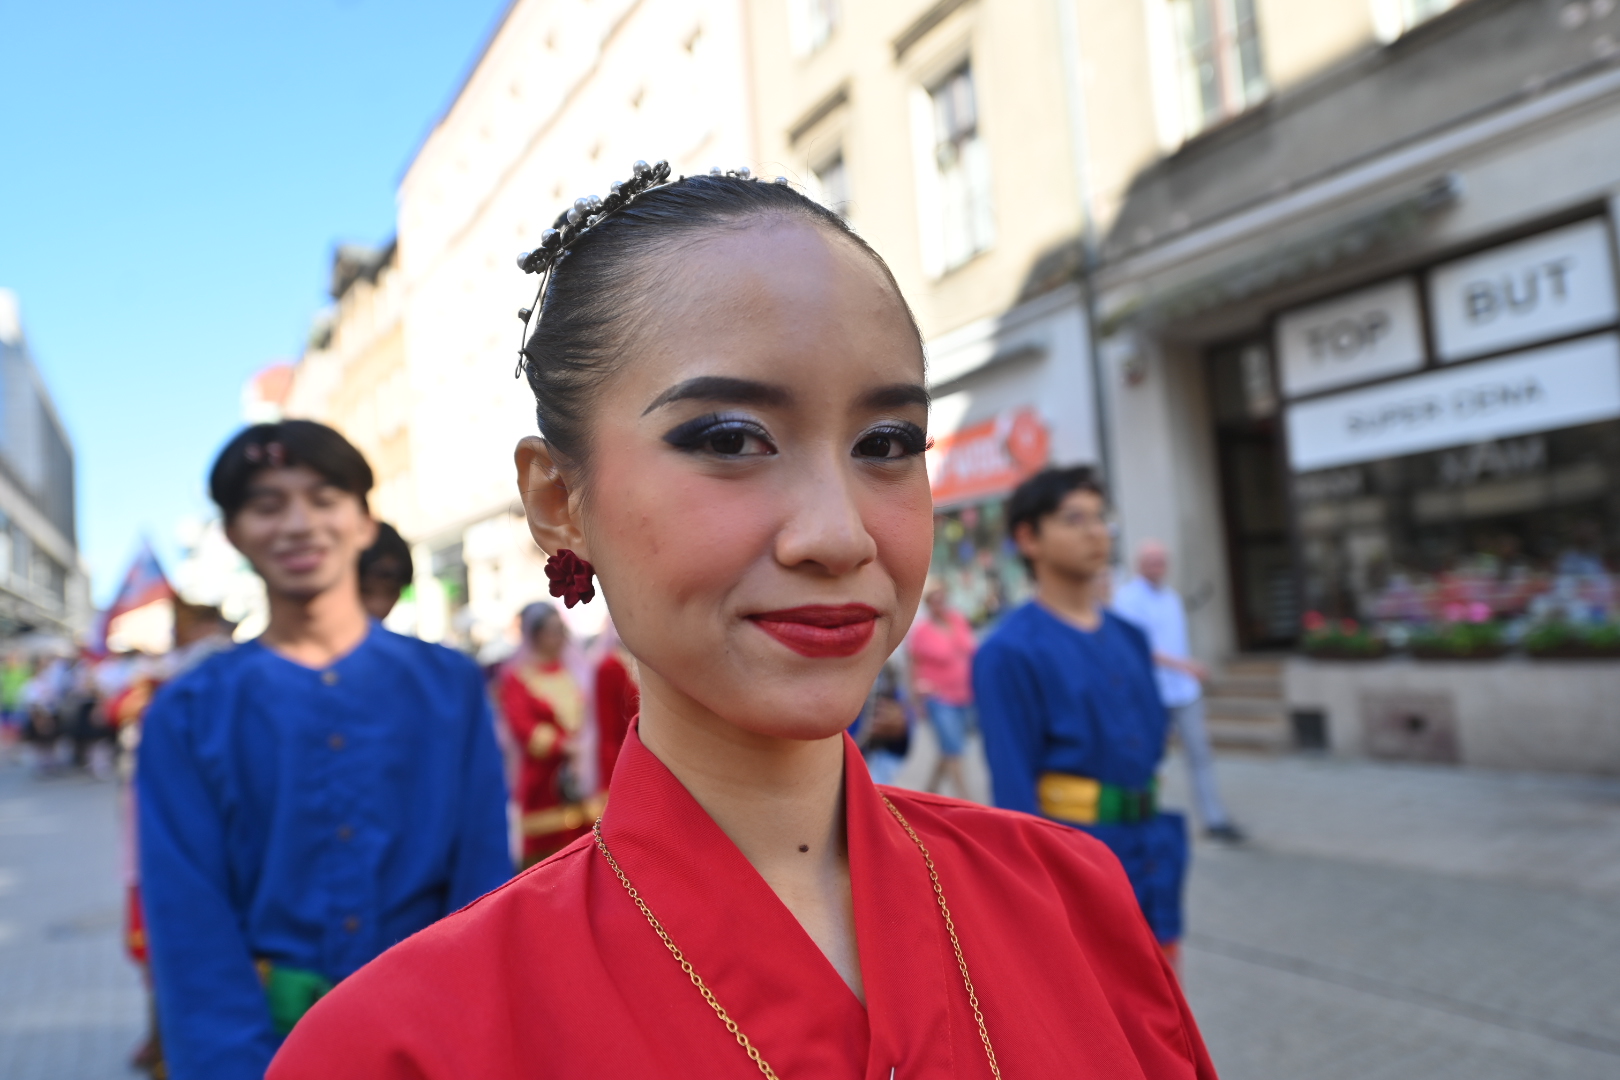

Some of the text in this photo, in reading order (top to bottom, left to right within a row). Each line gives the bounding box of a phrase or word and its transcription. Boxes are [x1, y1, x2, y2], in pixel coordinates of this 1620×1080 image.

[1305, 257, 1576, 363] TOP BUT
[1346, 377, 1544, 437] SUPER CENA
